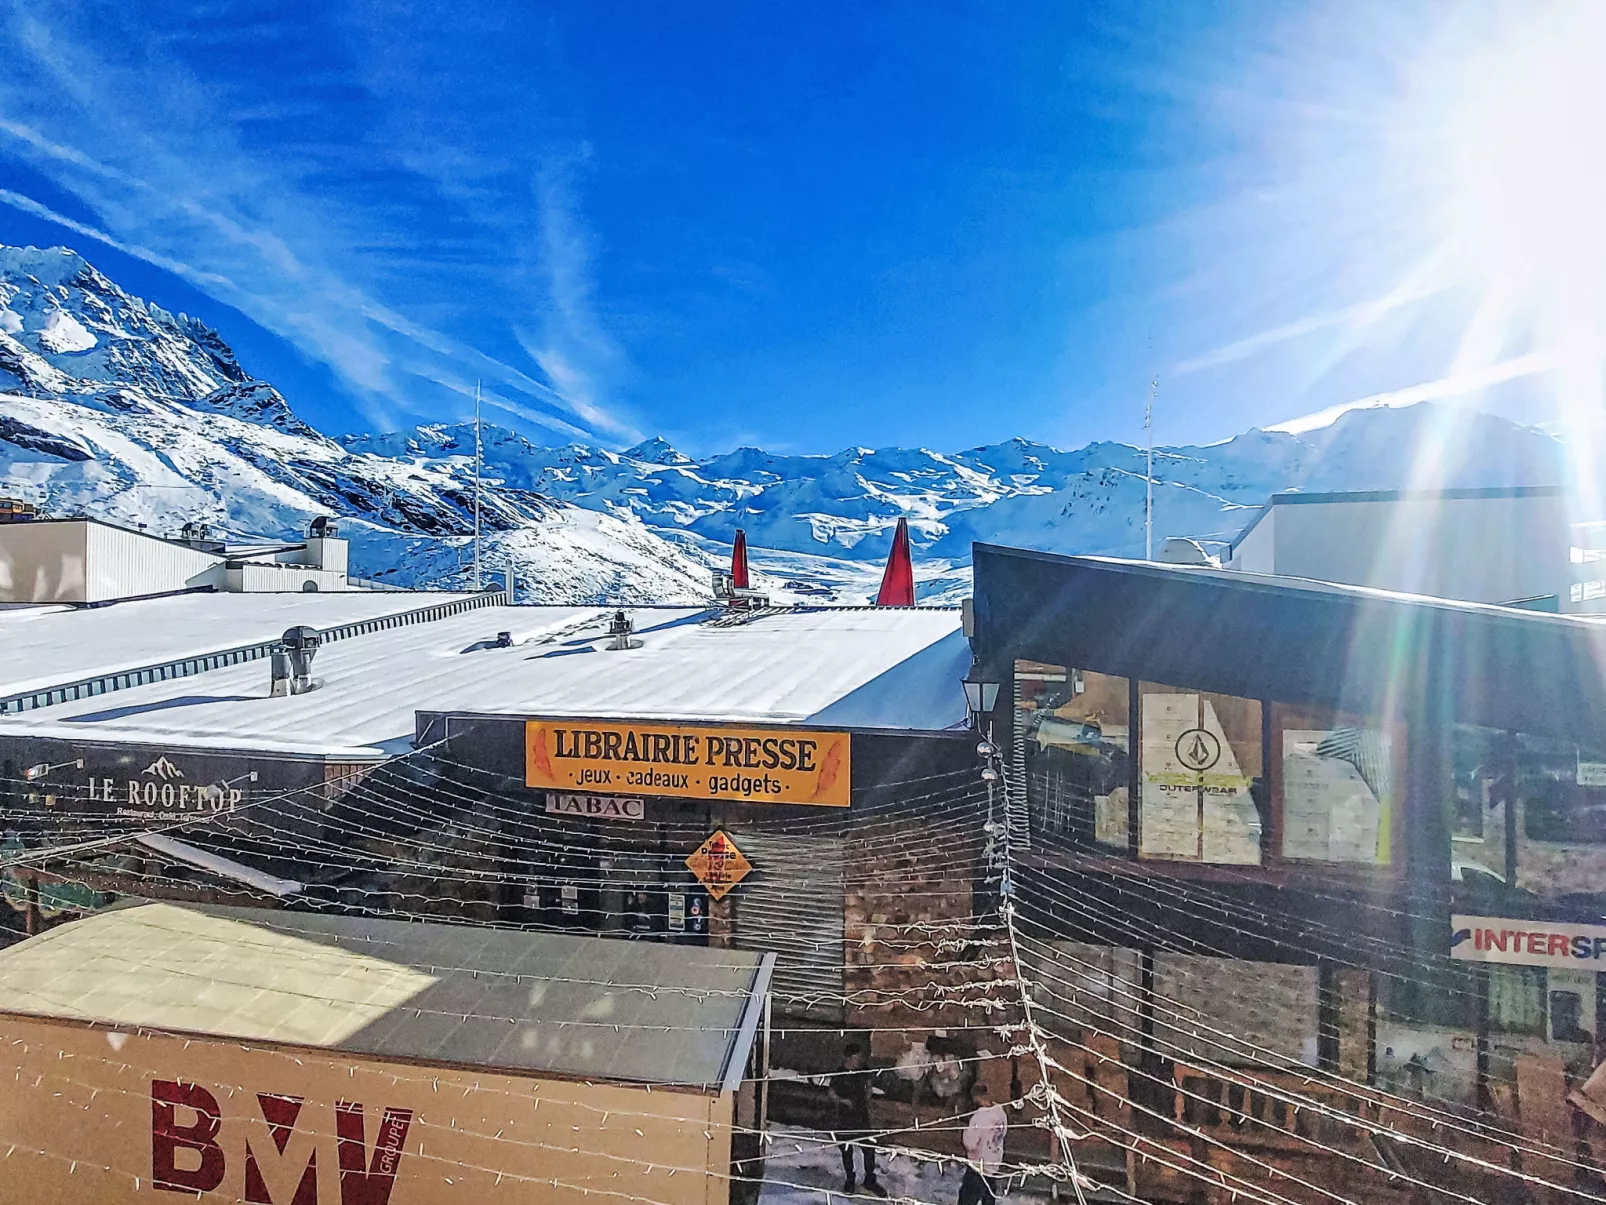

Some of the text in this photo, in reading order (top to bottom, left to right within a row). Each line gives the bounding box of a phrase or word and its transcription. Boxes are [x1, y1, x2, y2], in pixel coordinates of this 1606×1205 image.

[553, 729, 817, 771] LIBRAIRIE PRESSE
[88, 777, 242, 813] LE ROOFTOP
[576, 767, 782, 796] jeux cadeaux gadgets
[551, 794, 641, 817] TABAC
[380, 1118, 404, 1174] GROUPE
